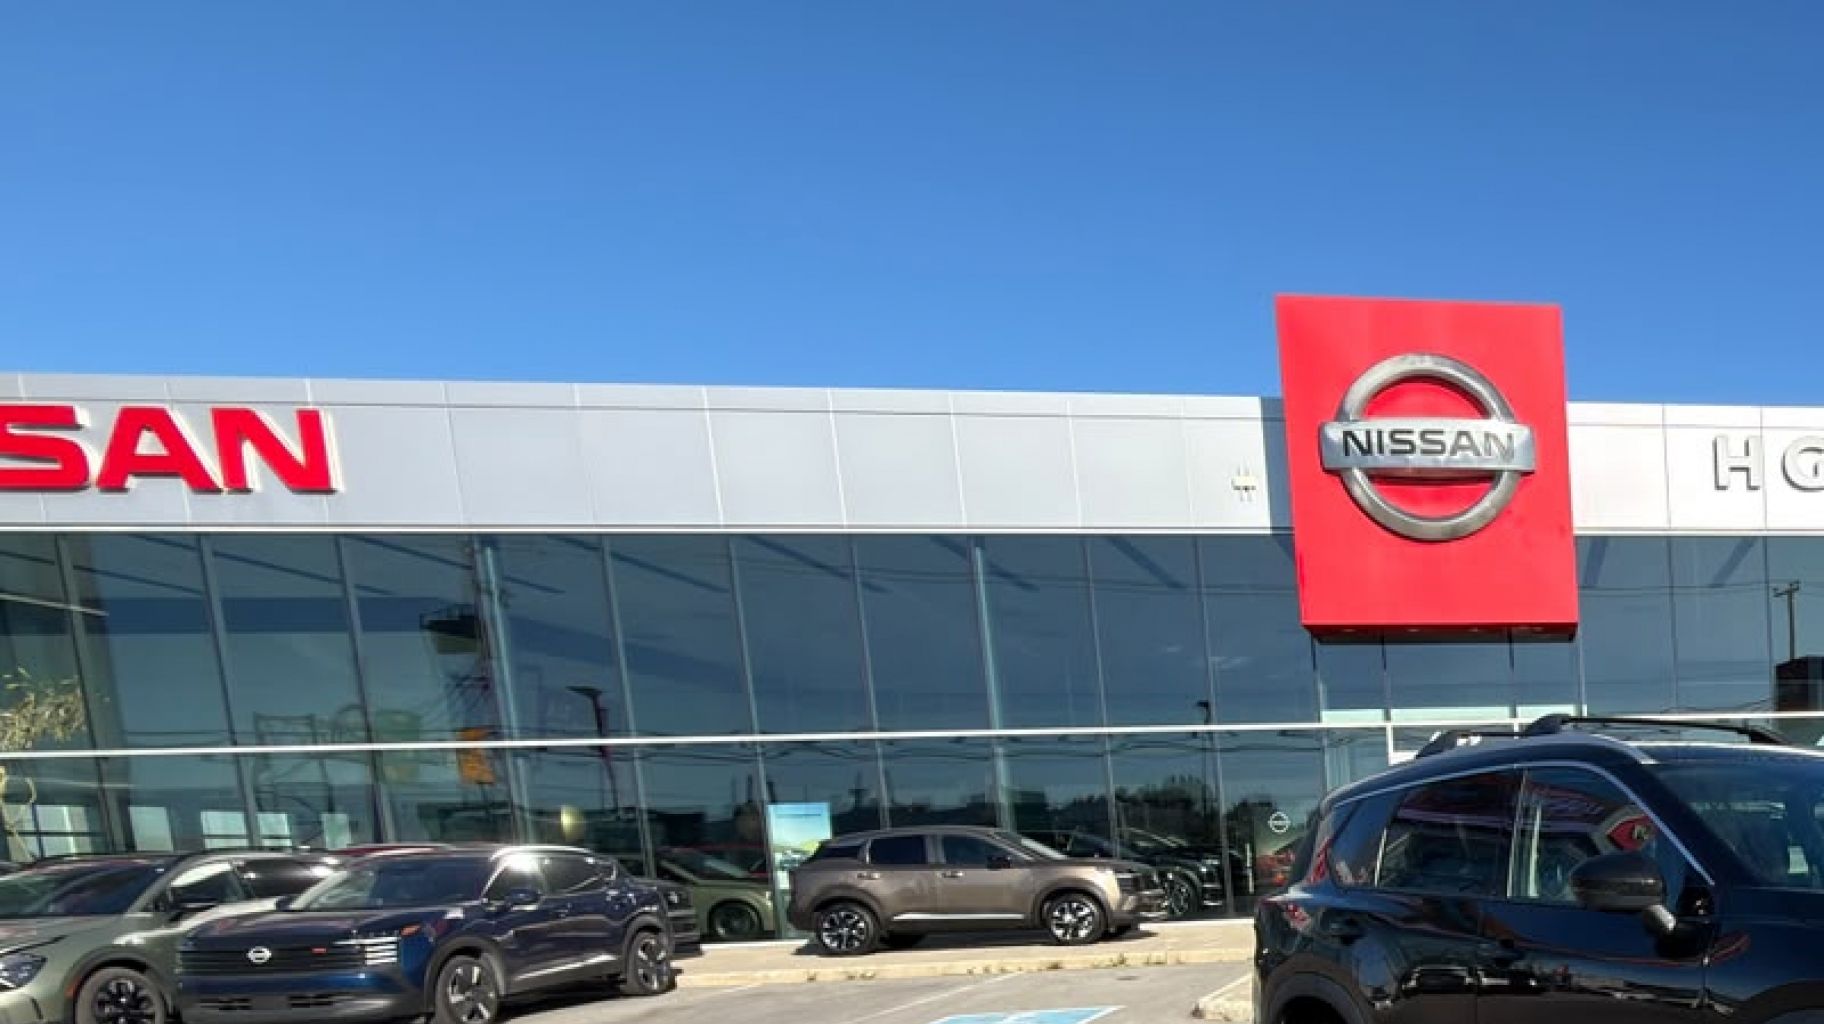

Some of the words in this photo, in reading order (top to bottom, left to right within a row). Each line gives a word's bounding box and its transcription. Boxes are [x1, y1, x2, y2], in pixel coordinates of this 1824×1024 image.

[0, 405, 337, 493] SAN
[1342, 428, 1515, 463] NISSAN
[1712, 434, 1762, 491] H
